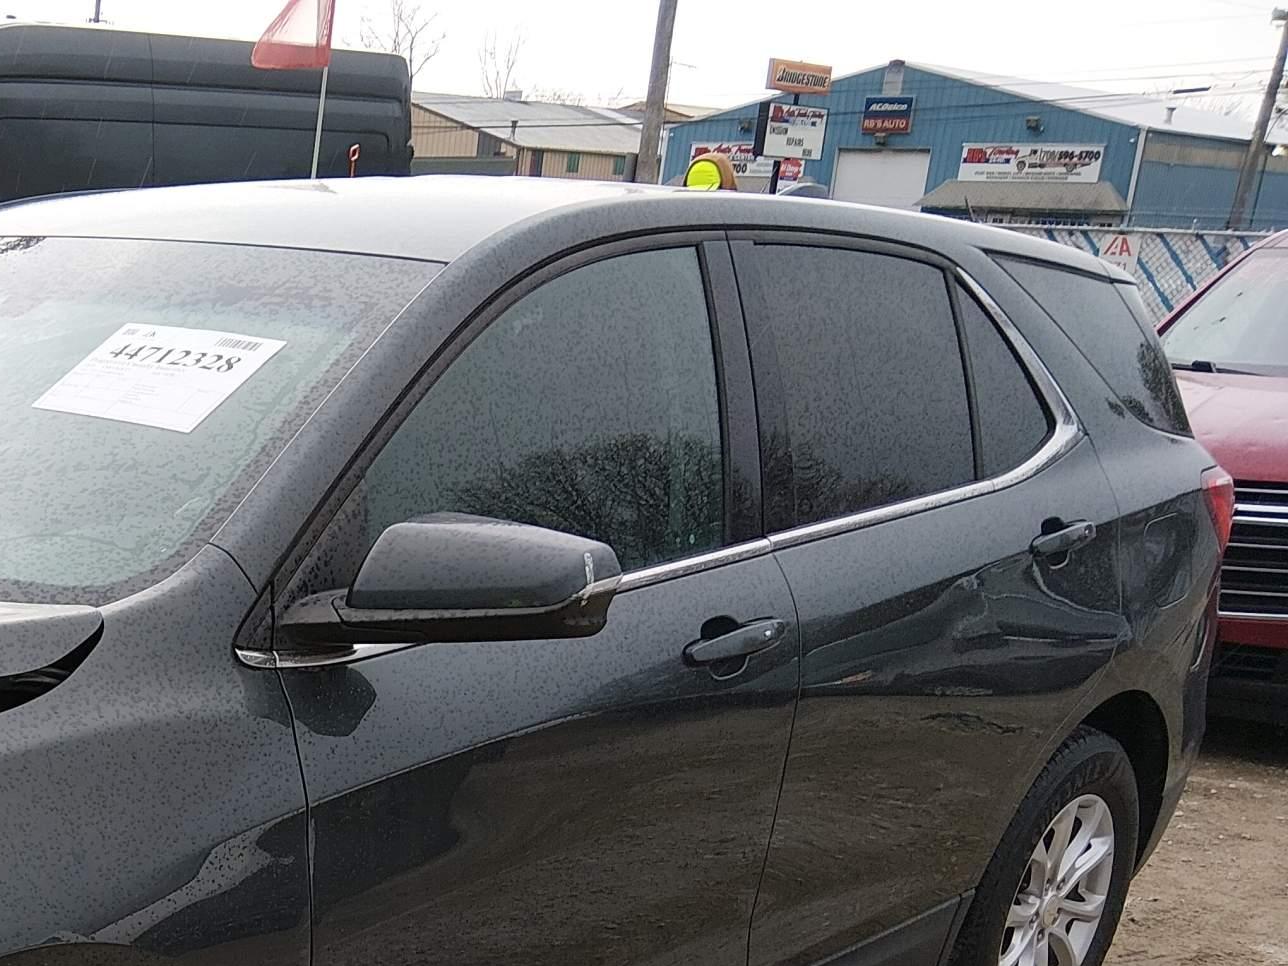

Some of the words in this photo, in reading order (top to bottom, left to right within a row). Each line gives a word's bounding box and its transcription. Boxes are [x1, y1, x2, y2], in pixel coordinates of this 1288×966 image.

[776, 67, 829, 88] BRIDGESTONE
[868, 102, 908, 112] ACDelco
[882, 119, 907, 128] AUTO
[109, 343, 242, 373] 44712328
